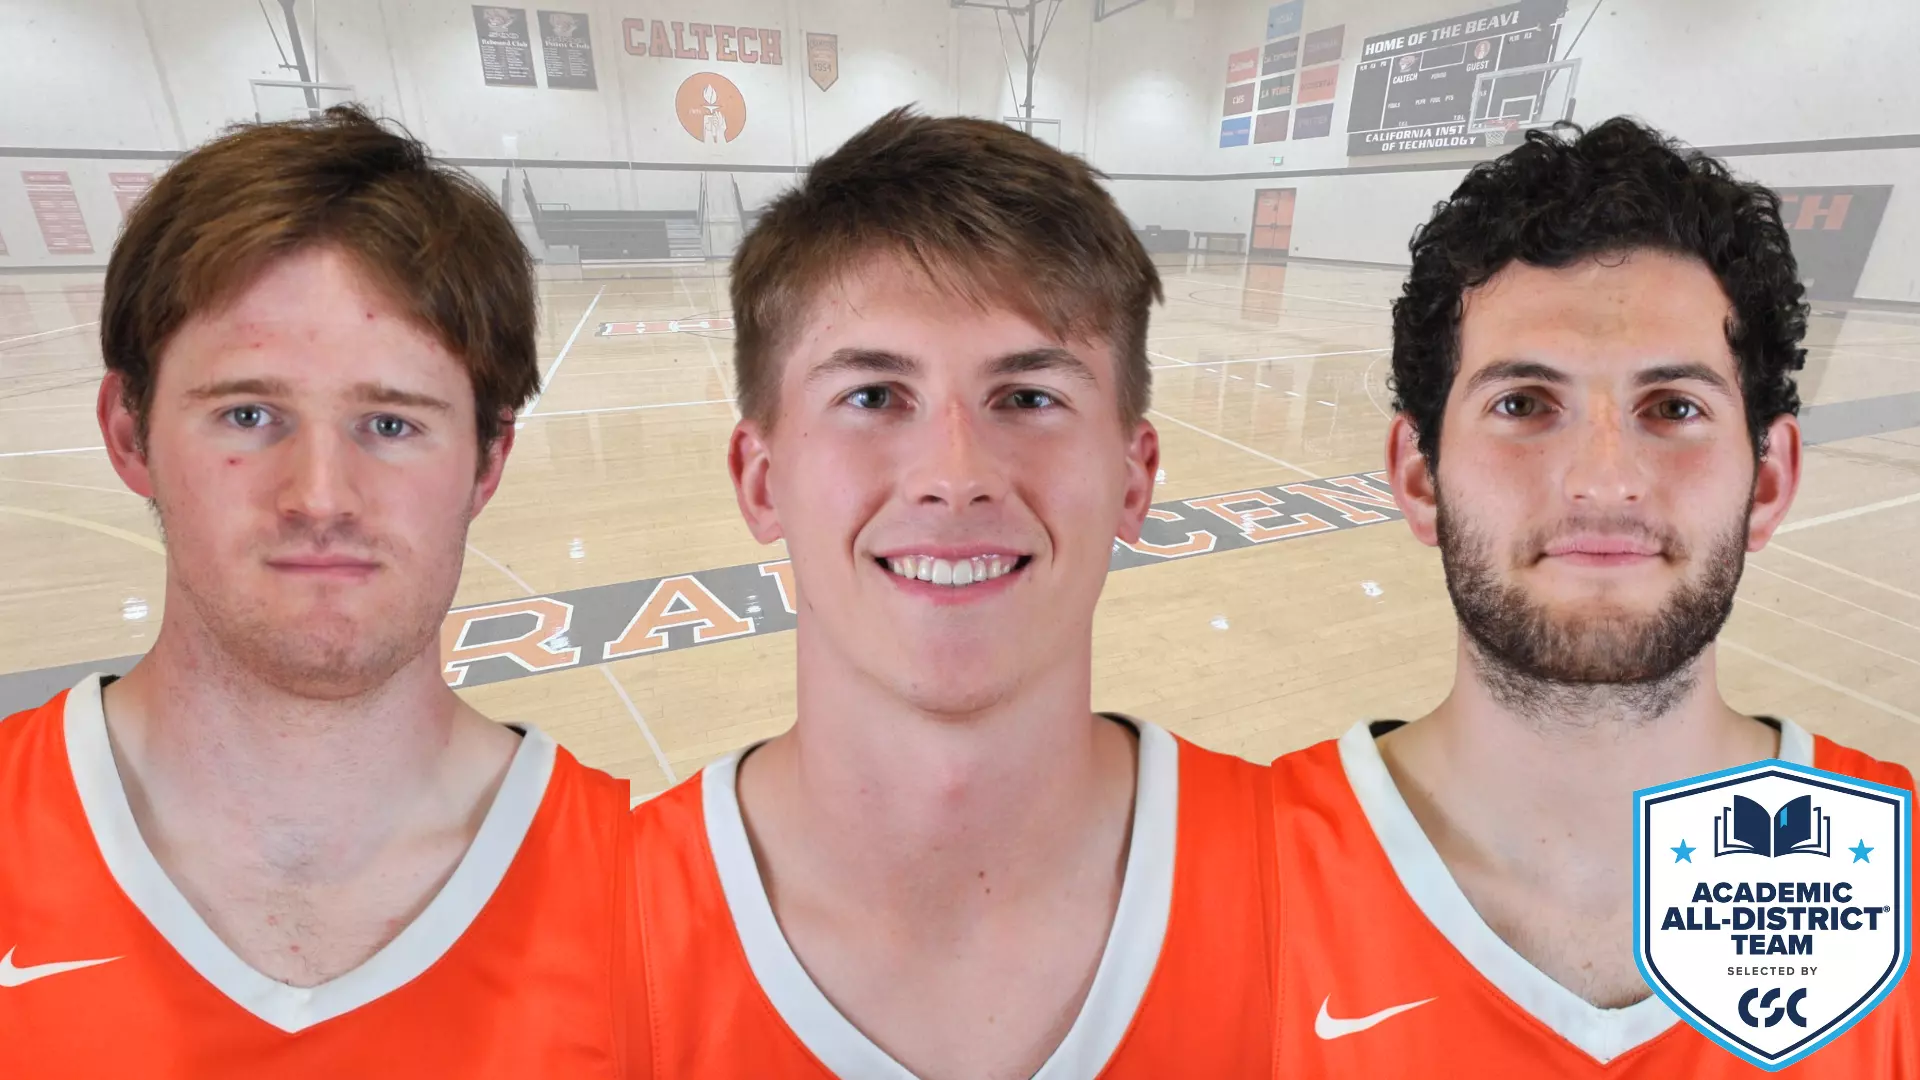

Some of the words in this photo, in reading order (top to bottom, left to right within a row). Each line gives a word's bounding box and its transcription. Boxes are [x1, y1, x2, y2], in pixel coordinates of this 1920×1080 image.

[621, 17, 783, 66] CALTECH
[1365, 39, 1405, 55] HOME
[1408, 33, 1428, 46] OF
[1431, 23, 1461, 41] THE
[814, 62, 832, 72] 1954
[1466, 60, 1490, 72] GUEST
[1392, 72, 1419, 85] CALTECH
[1365, 128, 1432, 143] CALIFORNIA
[1436, 125, 1465, 137] INST
[1381, 141, 1396, 152] OF
[1398, 136, 1477, 151] TECHNOLOGY
